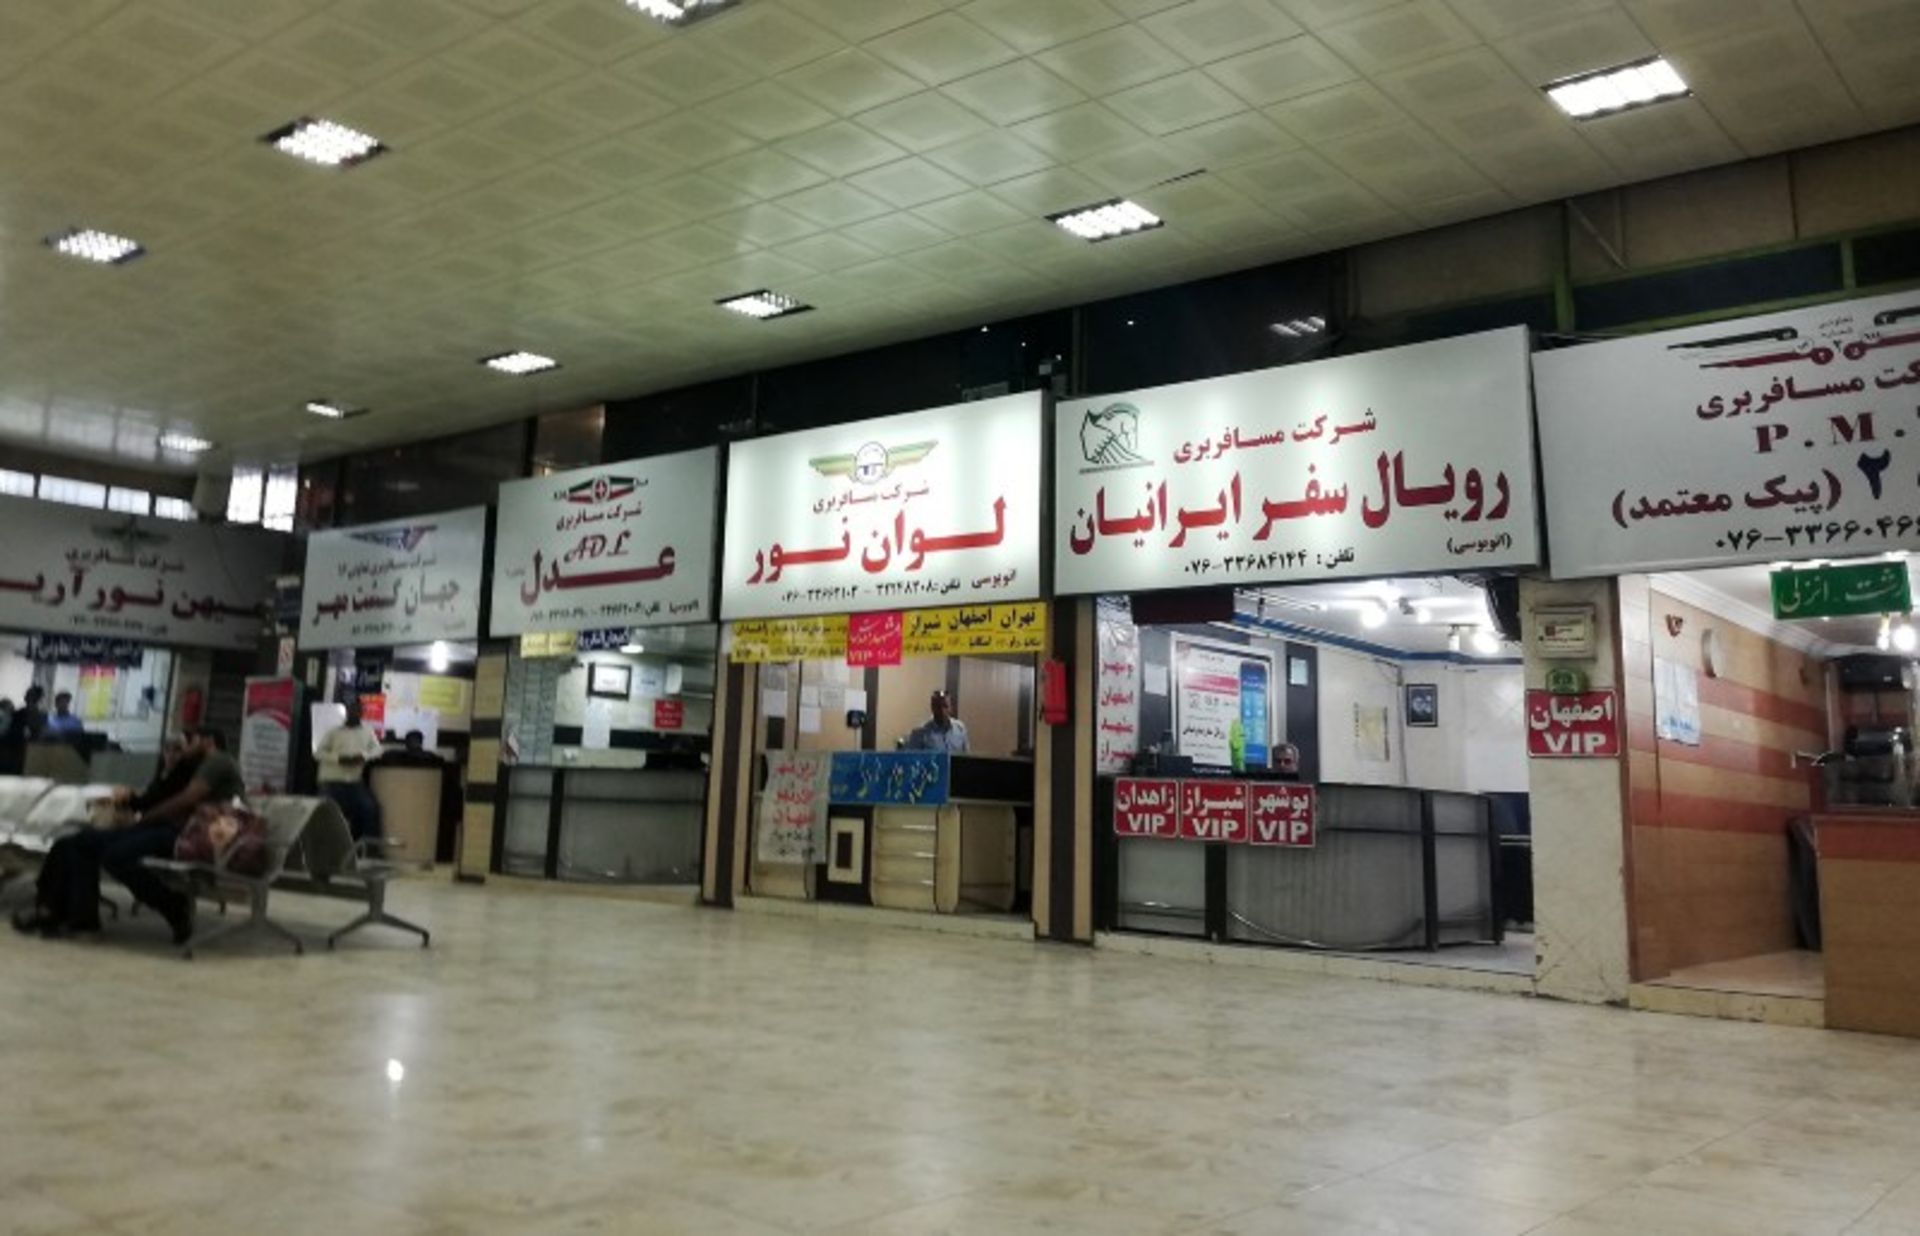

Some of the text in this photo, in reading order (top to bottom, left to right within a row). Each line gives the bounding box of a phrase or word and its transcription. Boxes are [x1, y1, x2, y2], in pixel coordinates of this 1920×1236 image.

[1696, 376, 1865, 420] مسافربری
[1173, 408, 1376, 464] شرکت مسافربری
[1362, 449, 1511, 529] رویال
[1857, 448, 1891, 500] ۲
[1253, 463, 1349, 541] سفر
[564, 530, 632, 563] ADL
[746, 496, 1007, 585] لوان نور
[521, 545, 677, 606] عدل
[1530, 695, 1613, 730] اصفهان
[1543, 731, 1606, 754] VIP
[1116, 784, 1176, 815] زاهدان
[1183, 786, 1245, 817] شیراز
[1254, 787, 1310, 819] بوشهر
[1128, 813, 1166, 834] VIP
[1191, 818, 1239, 838] VIP
[1256, 820, 1310, 842] VIP
